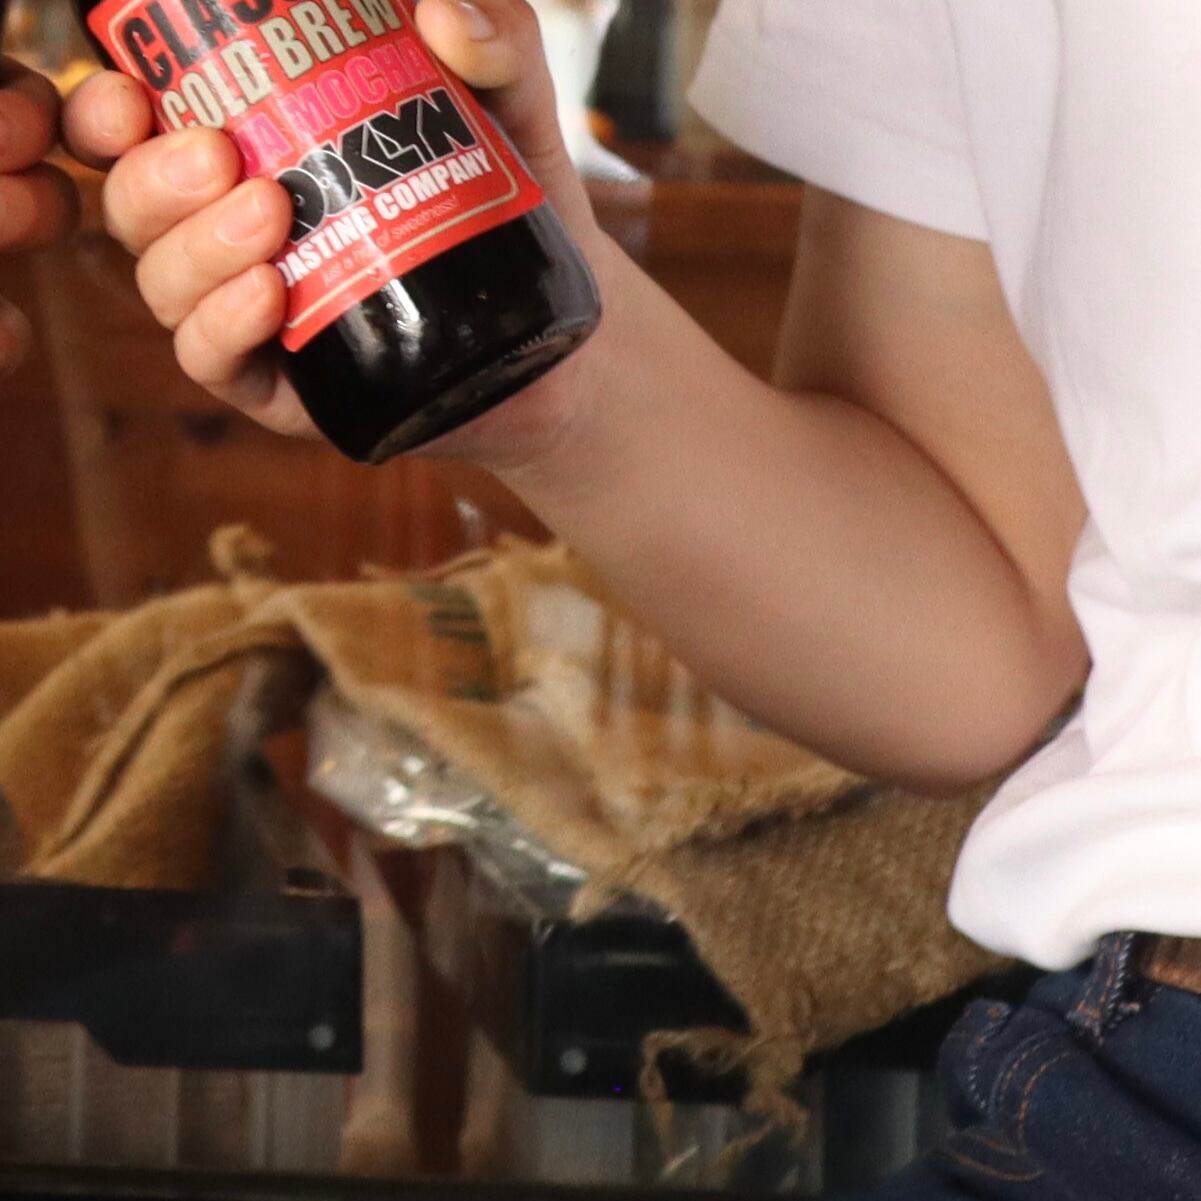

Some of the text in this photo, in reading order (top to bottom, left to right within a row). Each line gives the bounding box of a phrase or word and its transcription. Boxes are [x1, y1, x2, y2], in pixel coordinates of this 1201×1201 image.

[160, 39, 273, 131] COLD
[279, 36, 438, 136] MOCHA
[276, 205, 379, 288] ASTING
[374, 150, 493, 221] COMPANY
